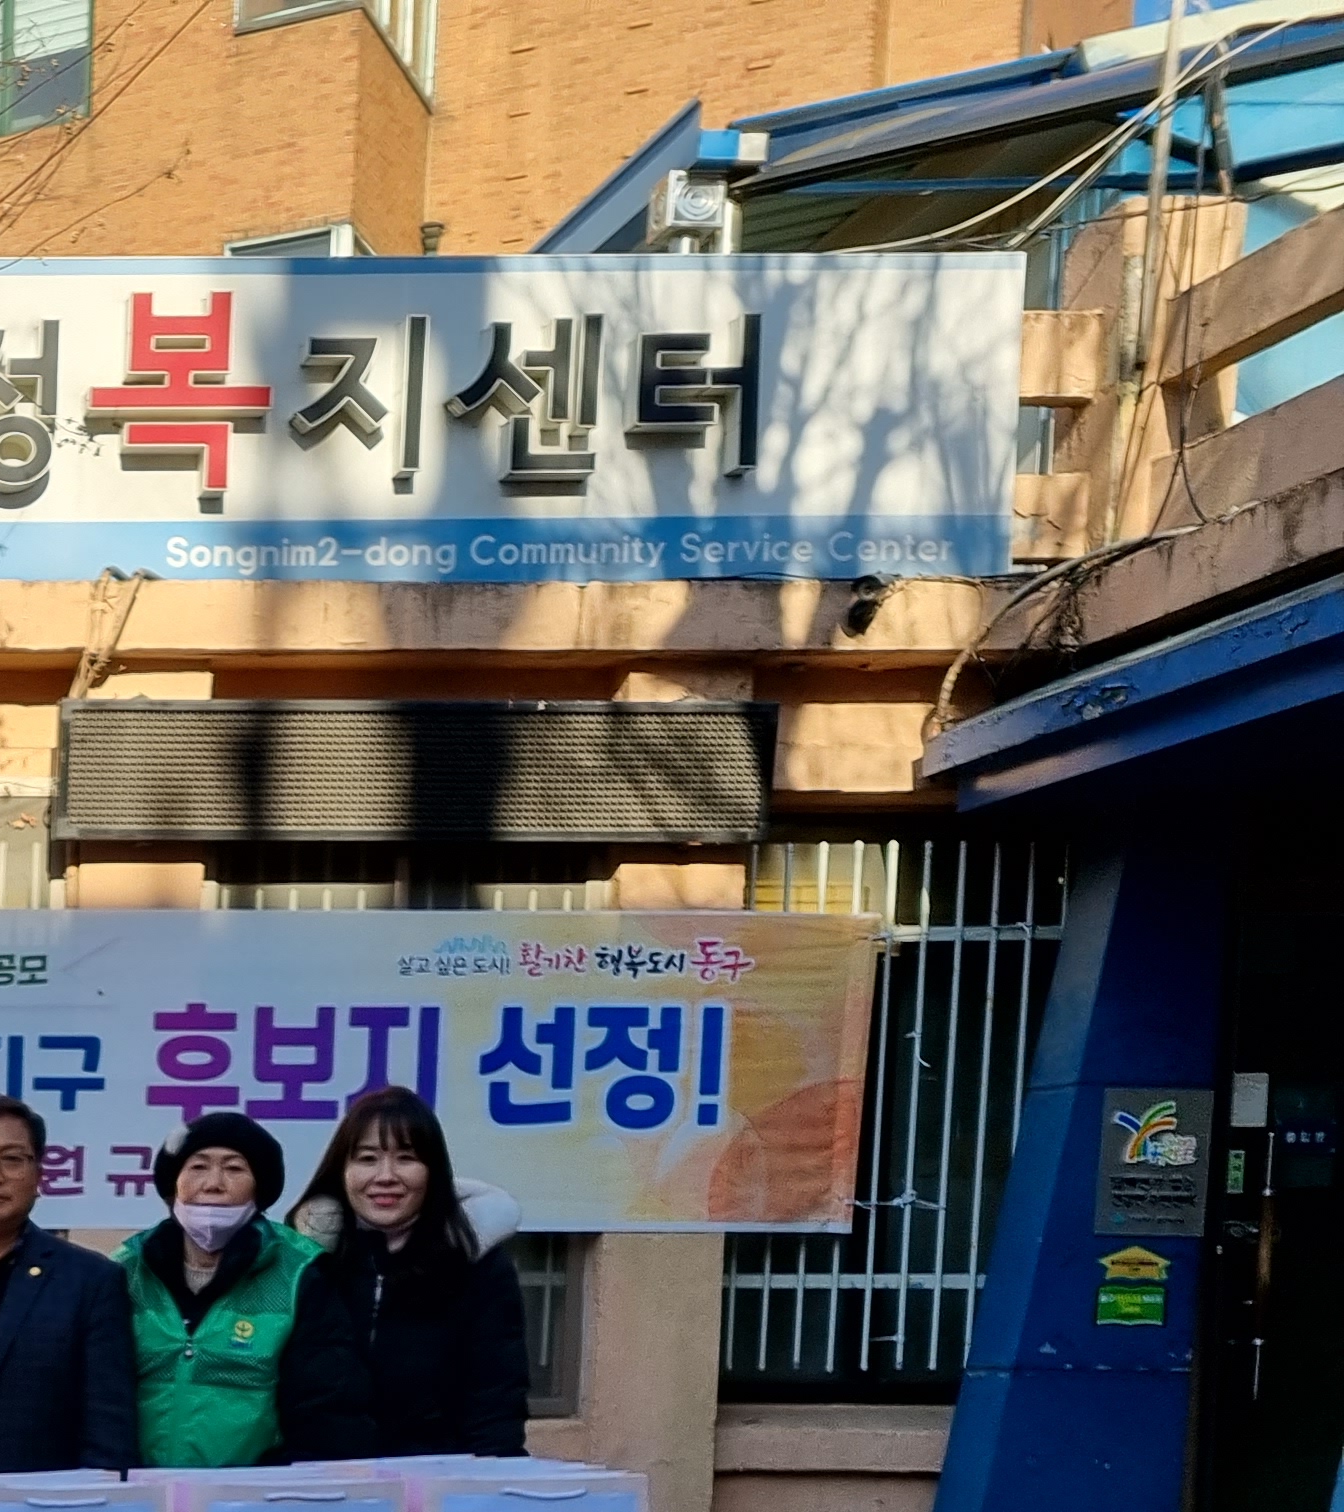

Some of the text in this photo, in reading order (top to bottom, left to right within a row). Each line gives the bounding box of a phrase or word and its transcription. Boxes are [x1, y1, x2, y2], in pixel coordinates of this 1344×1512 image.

[165, 530, 953, 575] Songnim2-dong Community Service Center
[517, 940, 588, 980] 활기찬
[595, 943, 686, 980] 행복도시
[691, 938, 755, 983] 동구
[146, 1002, 439, 1123] 후보지
[478, 1001, 727, 1132] 선정!
